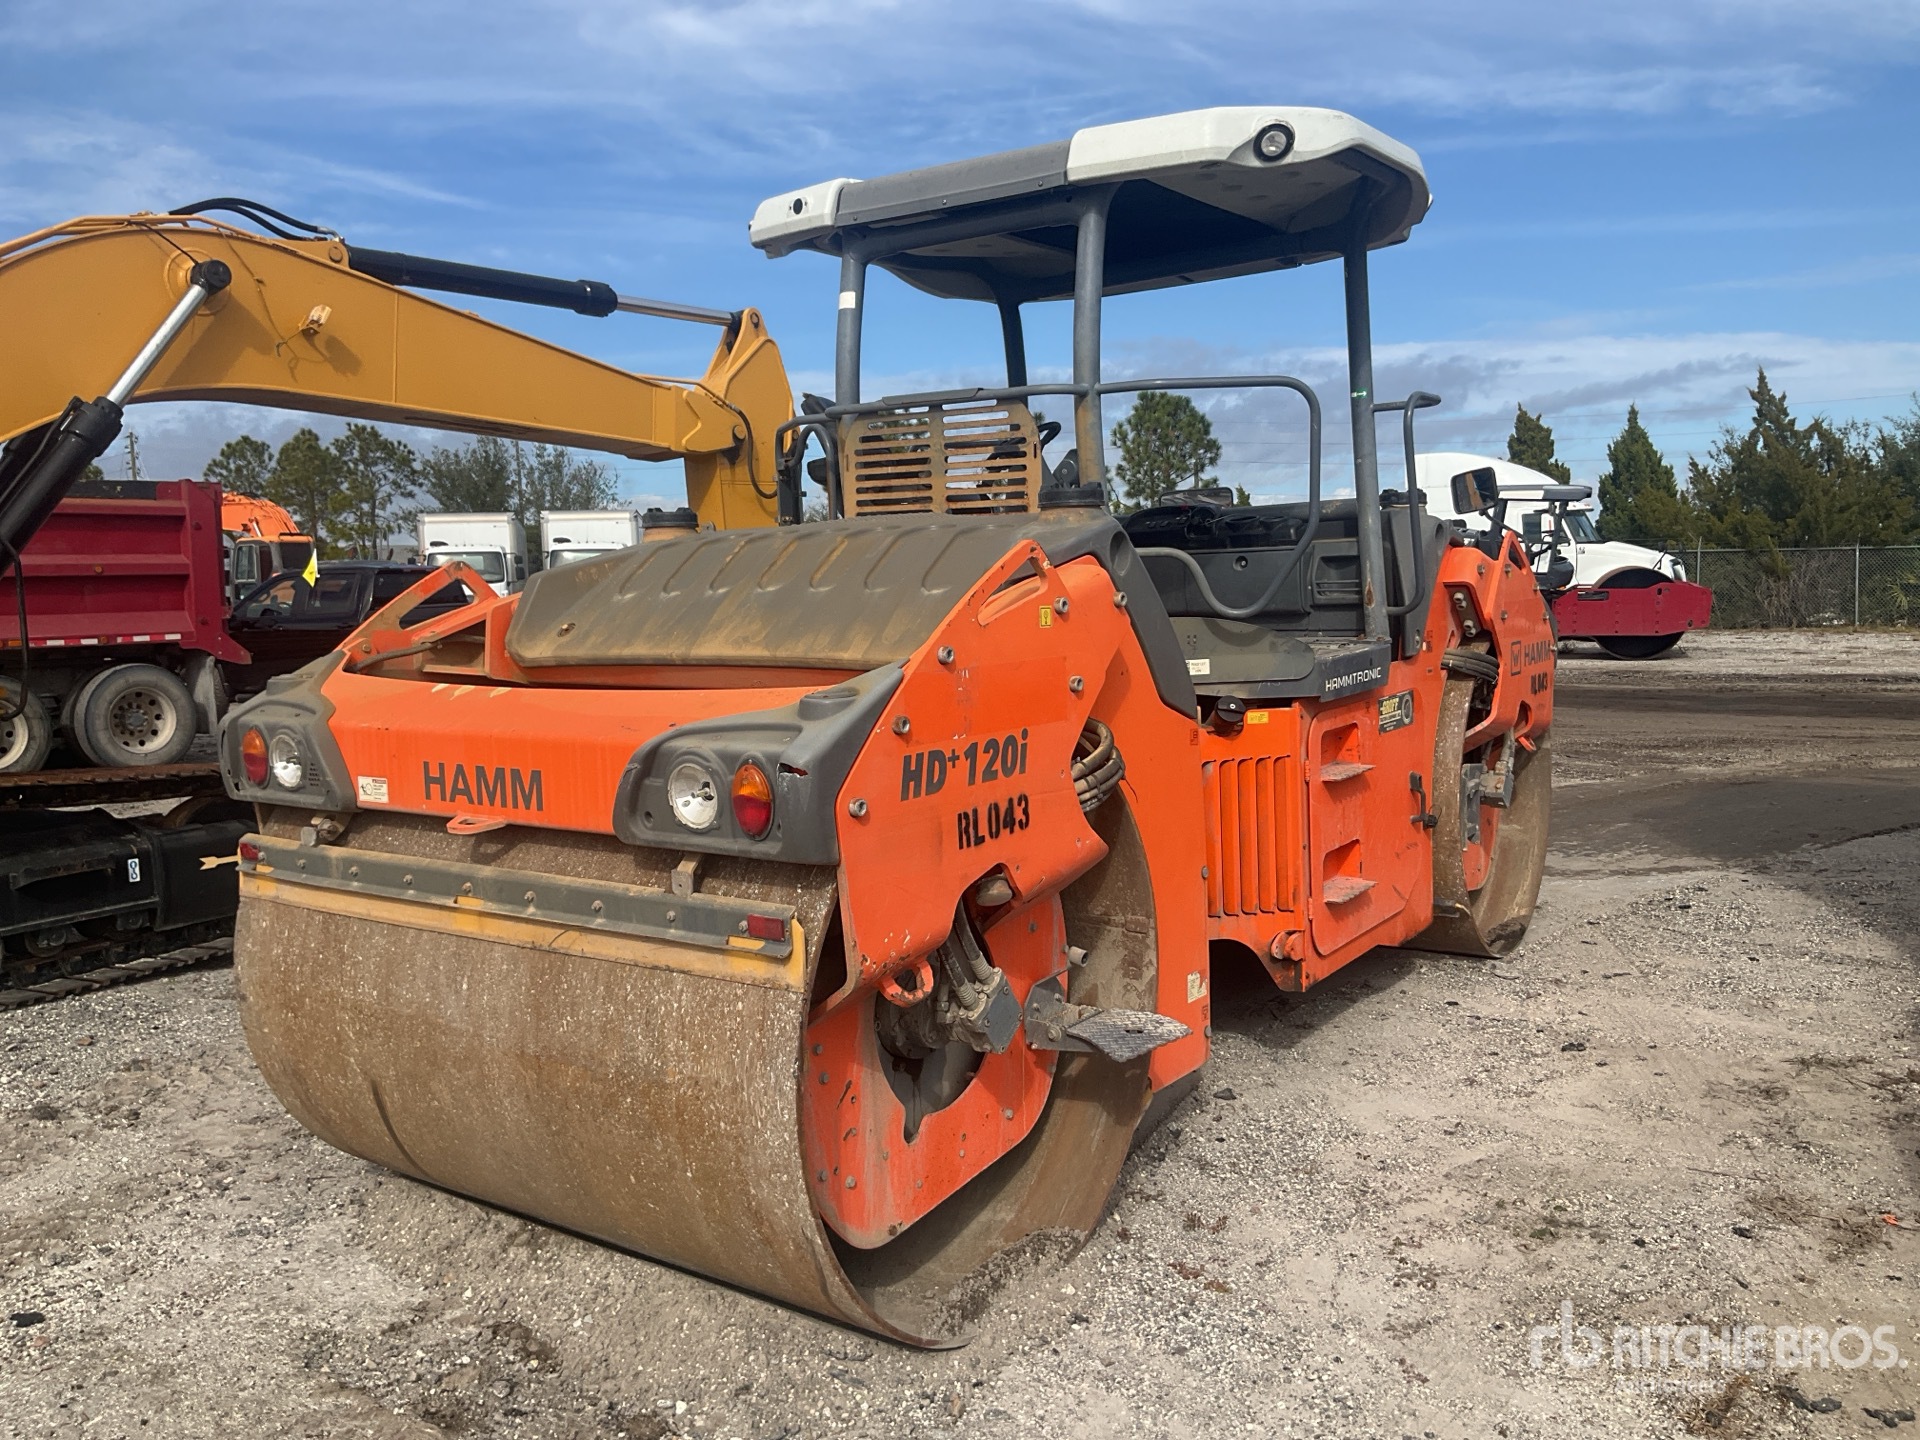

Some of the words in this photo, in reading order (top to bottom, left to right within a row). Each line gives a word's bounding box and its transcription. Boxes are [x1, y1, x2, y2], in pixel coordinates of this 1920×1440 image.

[1524, 640, 1551, 667] HAMM
[1325, 667, 1382, 692] HAMMTRONIC
[423, 761, 544, 812] HAMM
[957, 793, 1030, 850] RL043
